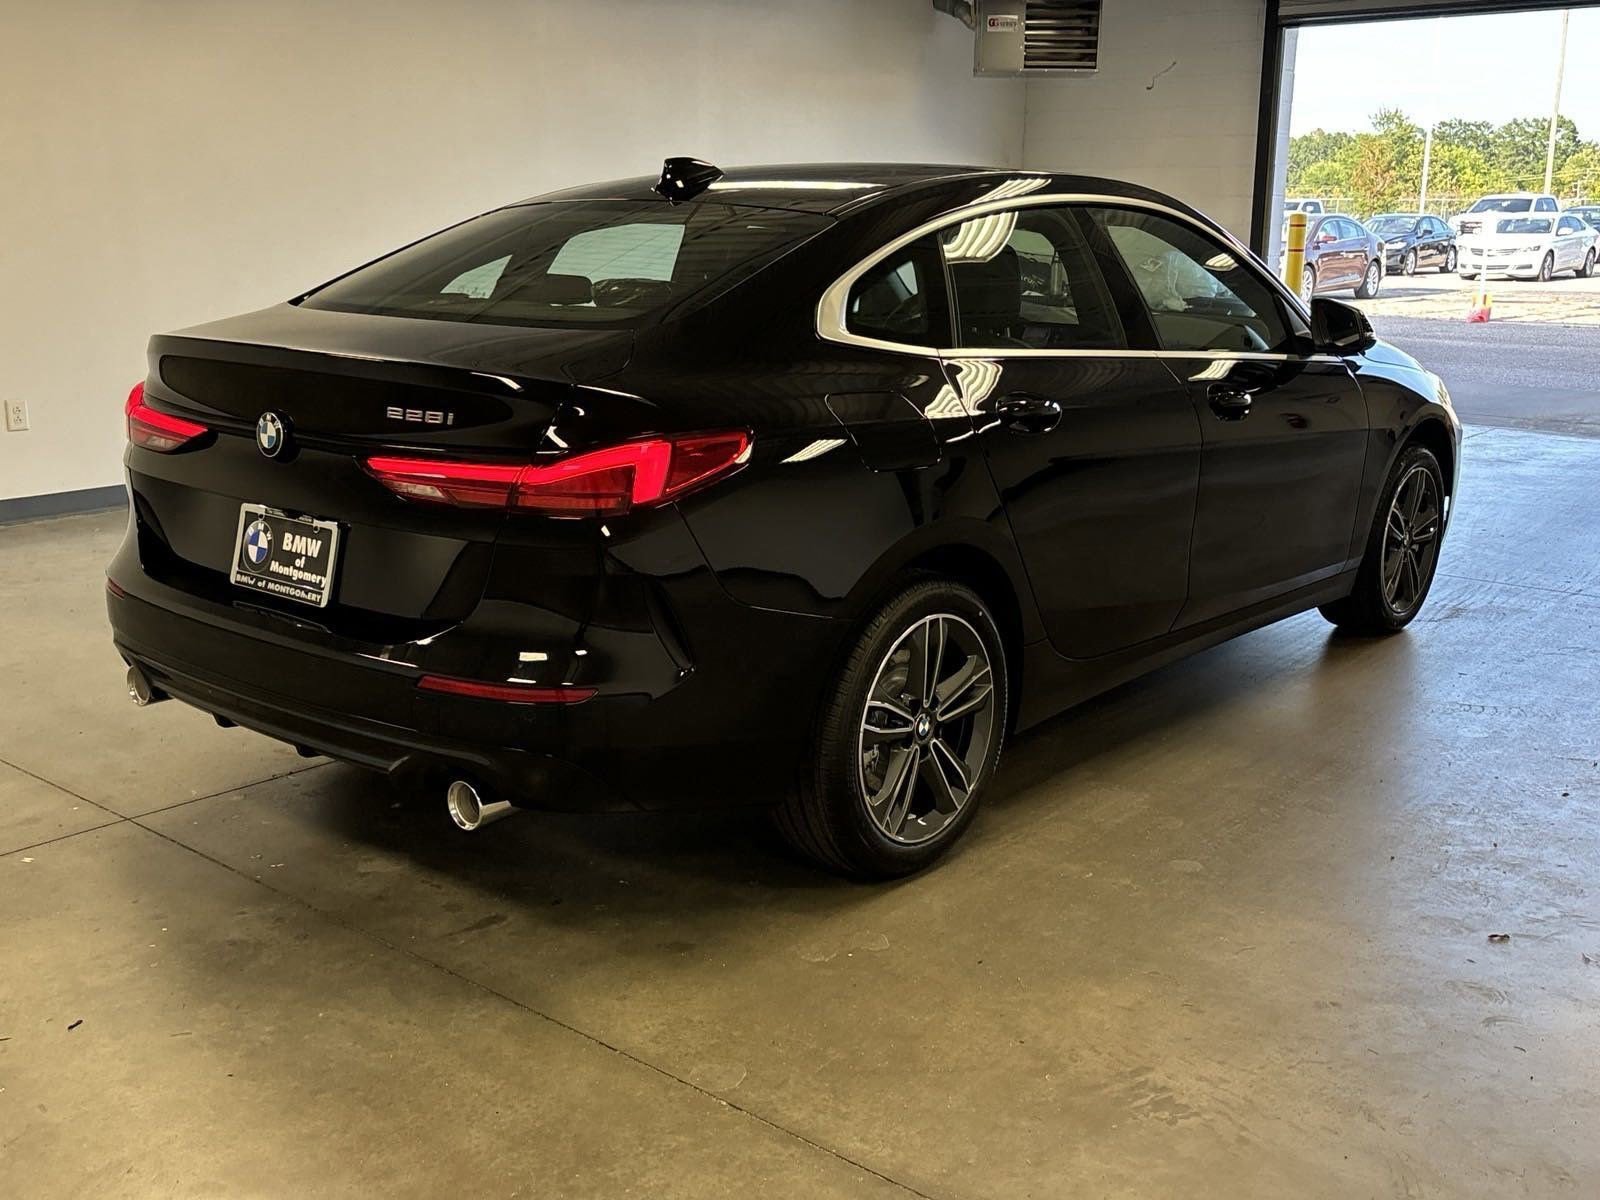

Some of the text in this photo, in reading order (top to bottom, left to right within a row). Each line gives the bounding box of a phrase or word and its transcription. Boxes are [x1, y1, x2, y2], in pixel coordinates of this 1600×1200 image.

[386, 406, 454, 425] 228i
[282, 532, 322, 558] BMW
[294, 556, 306, 568] of
[236, 574, 256, 585] BMW
[257, 580, 266, 588] of
[269, 560, 327, 588] Montgomery
